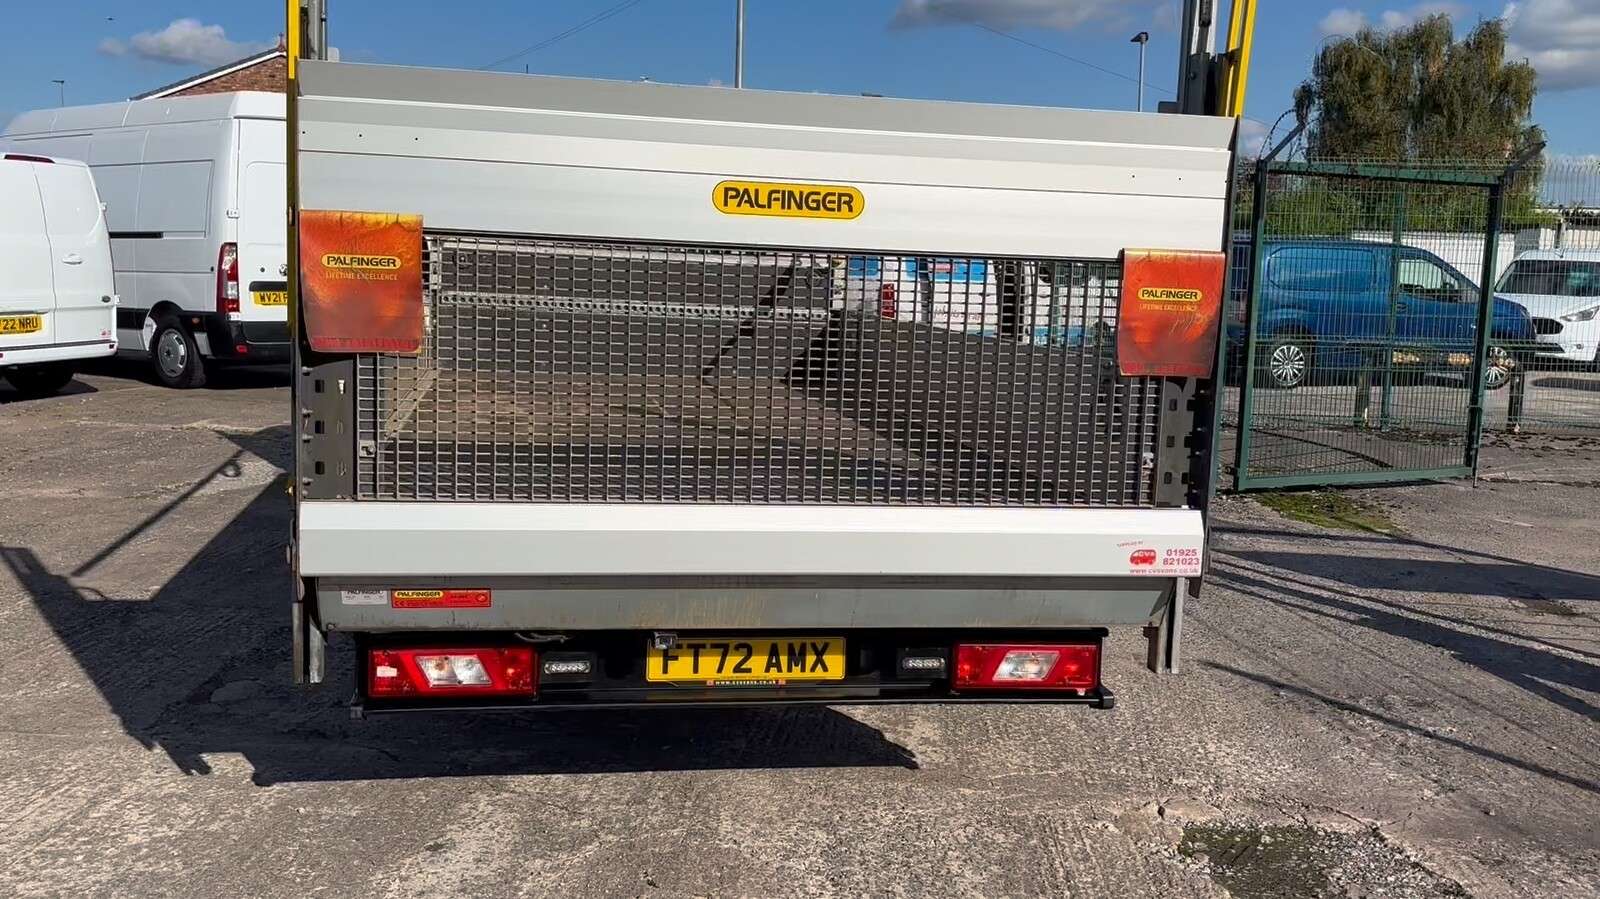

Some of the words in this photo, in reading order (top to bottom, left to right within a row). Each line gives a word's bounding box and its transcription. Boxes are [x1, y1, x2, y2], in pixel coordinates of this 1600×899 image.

[723, 187, 854, 213] PALFINGER
[326, 255, 397, 268] PALFINGER
[1141, 289, 1198, 299] PALFINGER
[18, 316, 38, 329] NRU
[1166, 549, 1197, 557] 01925
[1163, 558, 1200, 566] 821023
[661, 642, 753, 674] FT72
[764, 641, 831, 673] AMX
